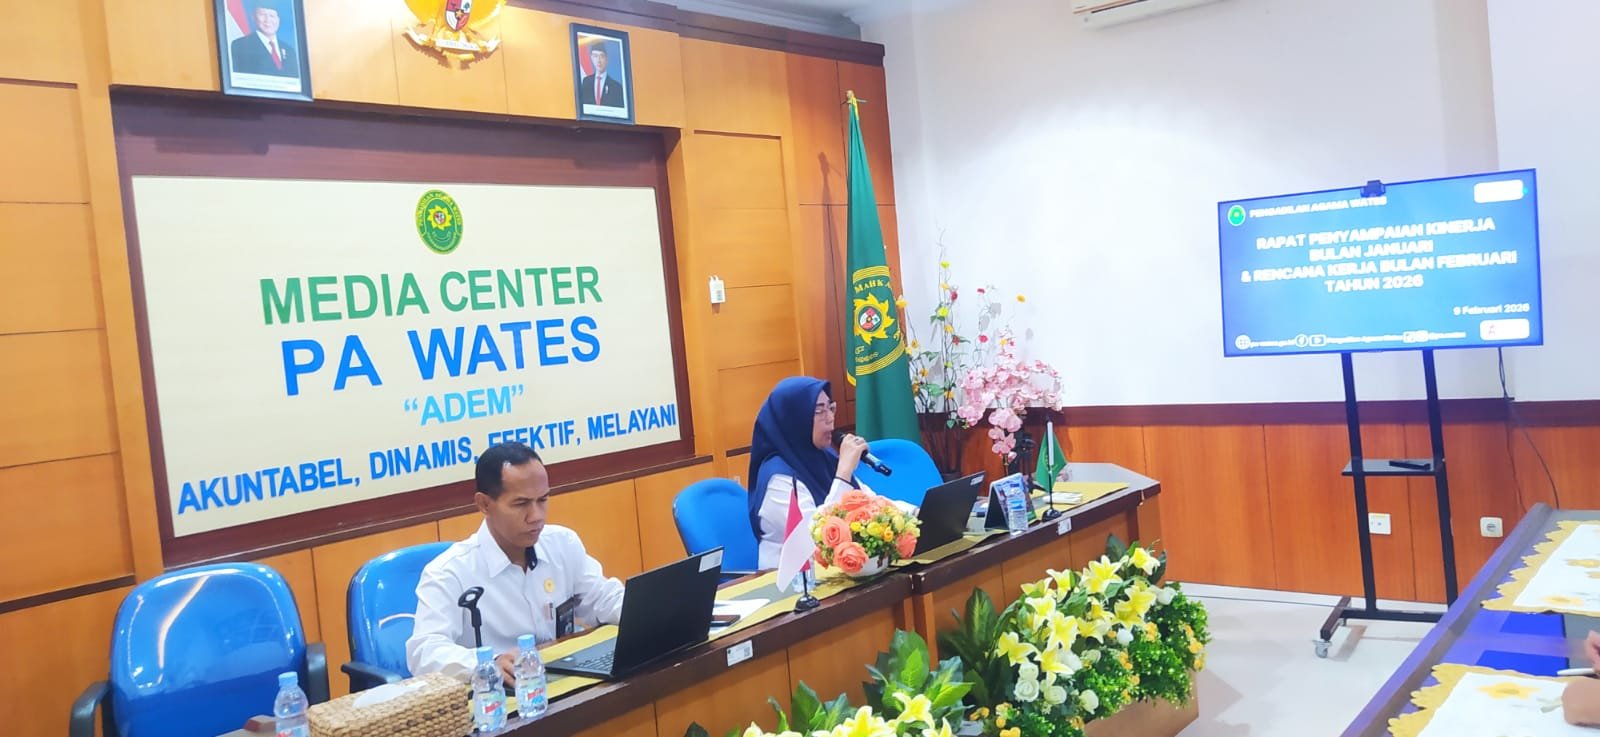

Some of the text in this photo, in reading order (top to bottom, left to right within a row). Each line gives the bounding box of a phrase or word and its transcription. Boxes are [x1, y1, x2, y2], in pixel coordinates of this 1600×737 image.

[1256, 217, 1495, 250] RAPAT PENYAMPAIAN KINERJA
[1241, 251, 1517, 282] & RENCANA KERJA BULAN FEBRUARI
[1310, 240, 1433, 262] BULAN JANUARI
[260, 265, 602, 325] MEDIA CENTER
[1325, 275, 1423, 292] TAHUN 2026
[1453, 303, 1529, 315] 9 Februari 2026
[281, 315, 600, 395] PA WATES
[177, 458, 361, 514] AKUNTABEL,
[588, 404, 676, 439] MELAYANI
